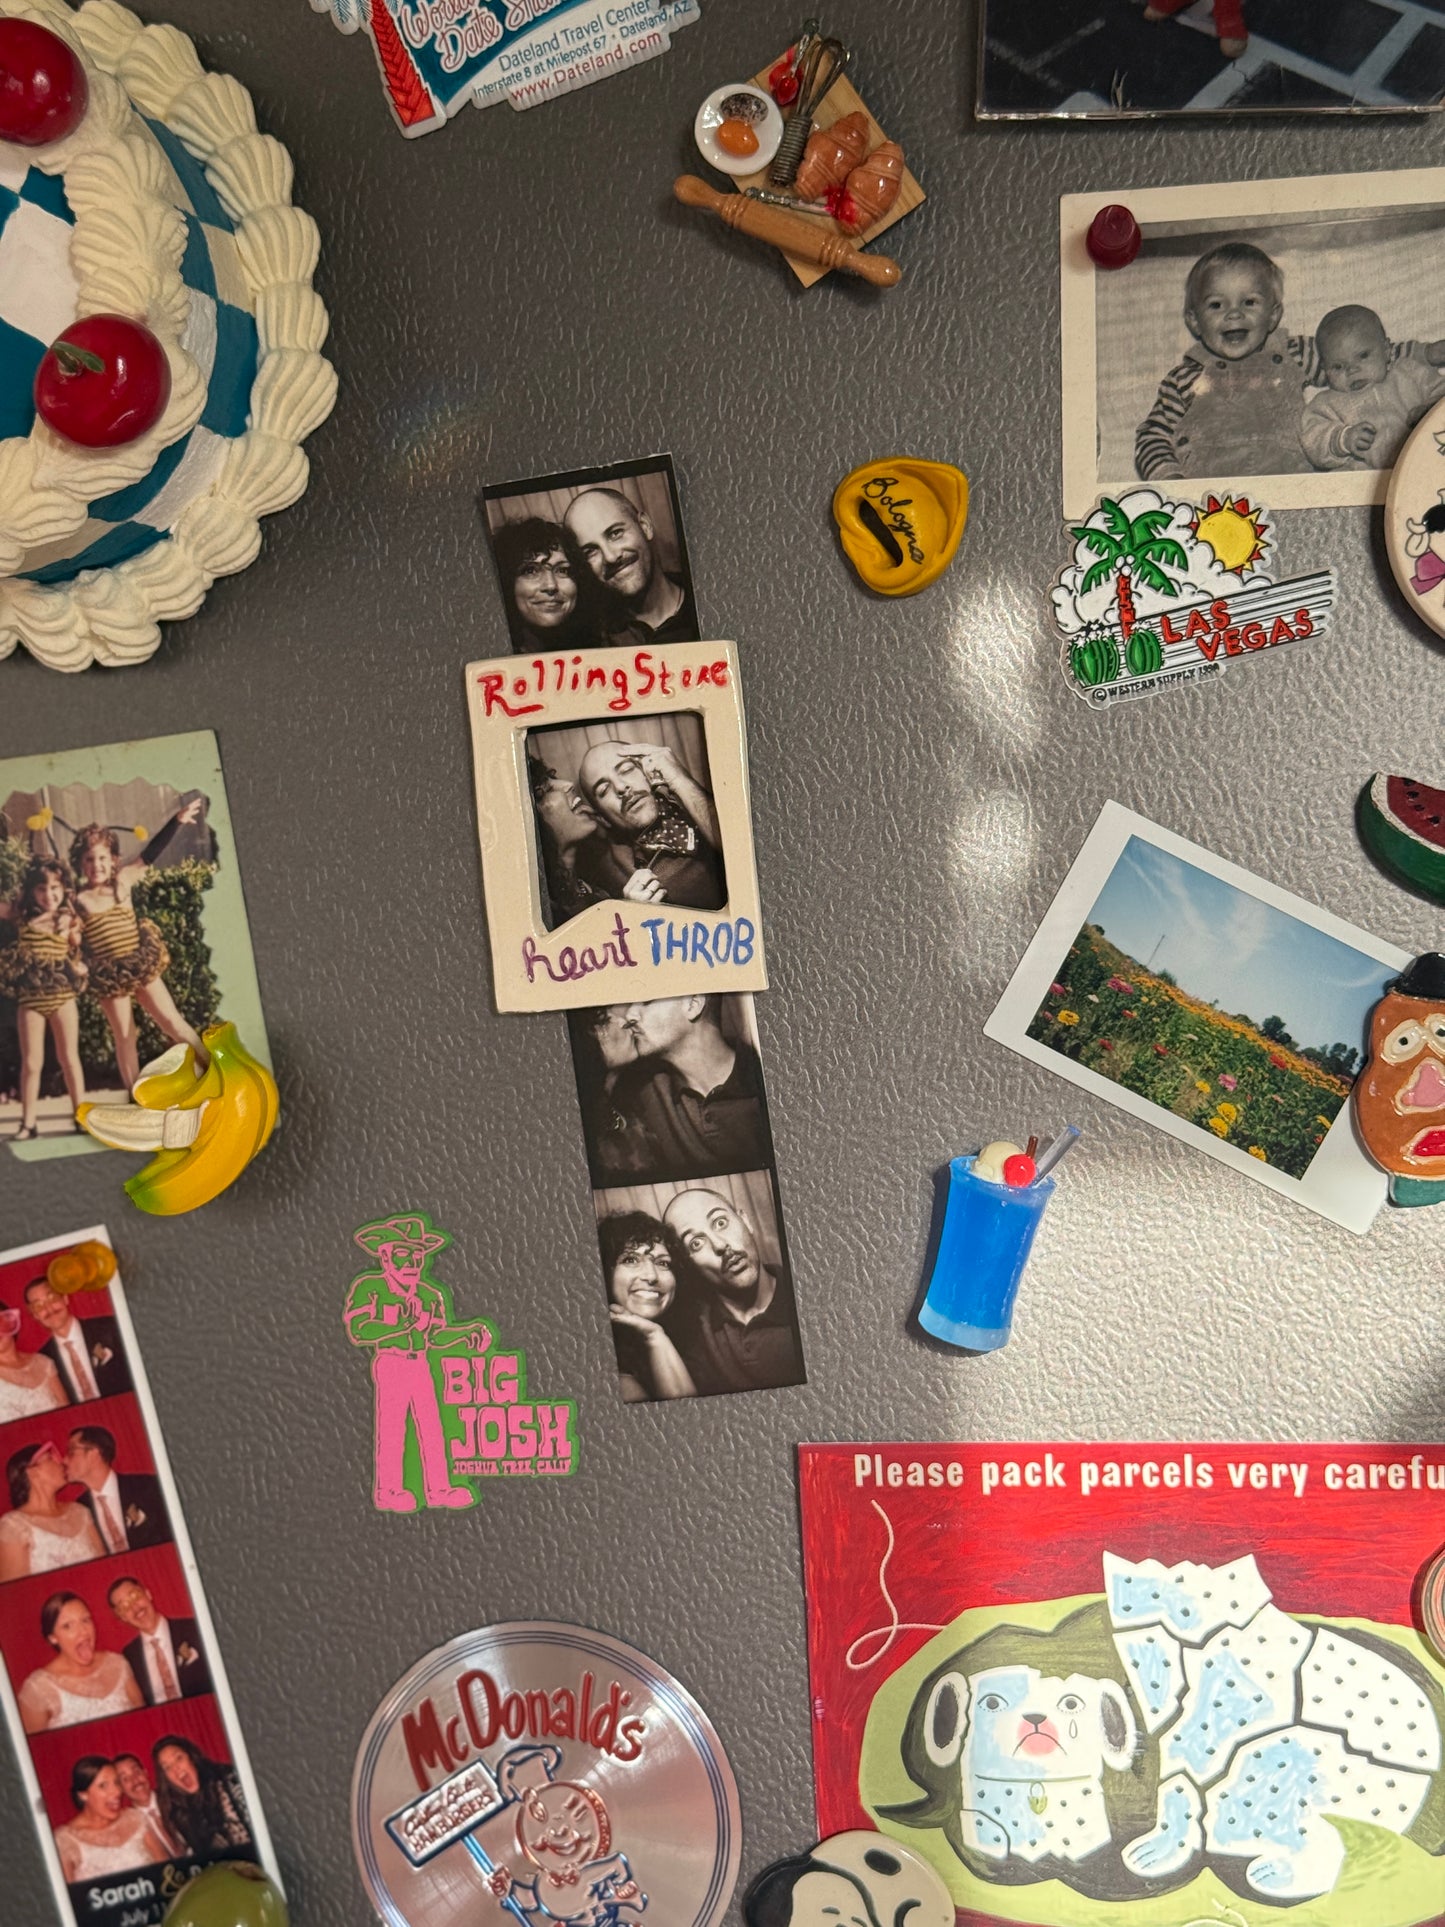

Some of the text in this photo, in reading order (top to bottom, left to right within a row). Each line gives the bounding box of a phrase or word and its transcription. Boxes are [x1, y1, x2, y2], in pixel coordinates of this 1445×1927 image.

[437, 9, 501, 70] Date
[473, 0, 692, 99] Interstate 8 at Milepost 67 Dateland, AZ
[499, 0, 652, 72] Dateland Travel Center
[510, 31, 663, 101] www.Dateland.com
[861, 477, 925, 565] Bologna
[1160, 600, 1231, 645] LAS
[1196, 608, 1314, 662] VEGAS
[1158, 667, 1196, 686] SUPPLY
[521, 911, 756, 984] heart THROB
[441, 1355, 519, 1405] BIG
[450, 1404, 572, 1459] JOSH
[854, 1452, 1445, 1498] Please pack parcels very carefu
[402, 1669, 648, 1791] McDonald's
[88, 1877, 156, 1910] Sarah
[121, 1907, 149, 1927] July
